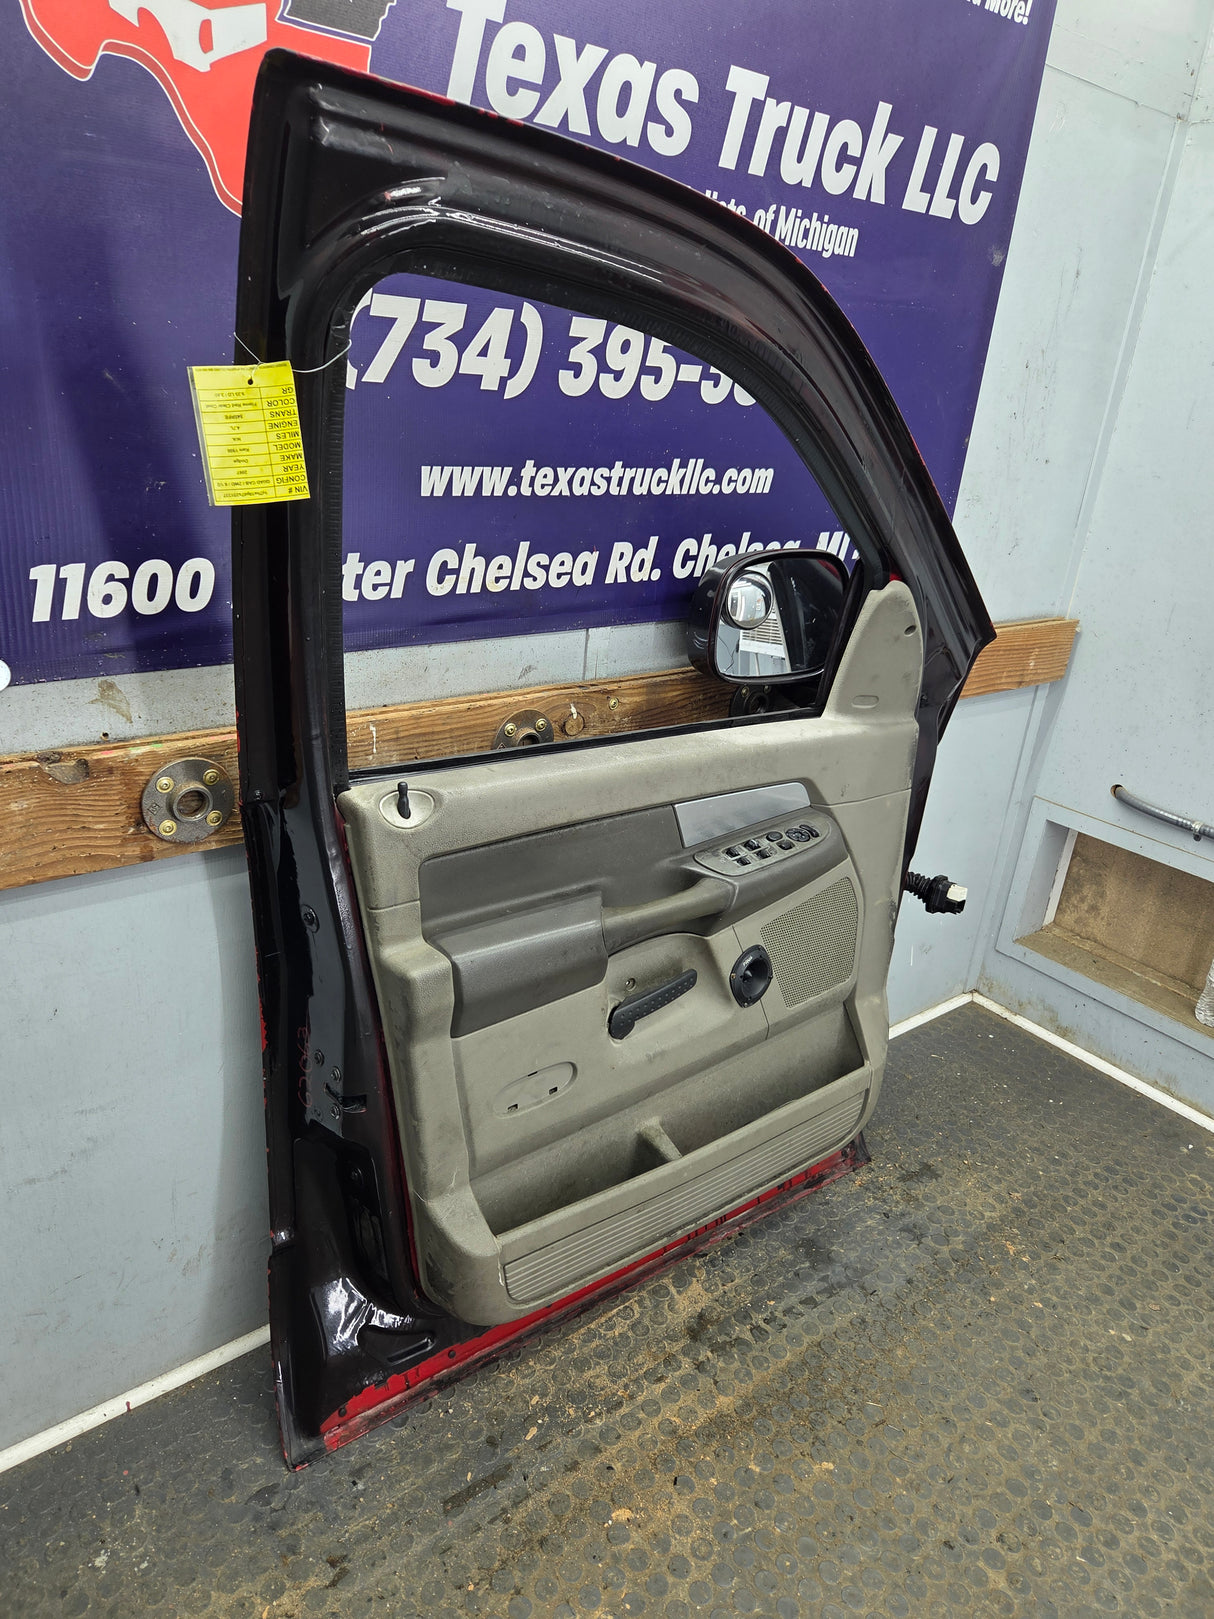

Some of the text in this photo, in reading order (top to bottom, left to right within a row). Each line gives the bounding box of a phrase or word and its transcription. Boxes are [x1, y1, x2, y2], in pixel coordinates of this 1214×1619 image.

[446, 0, 1001, 225] Texas Truck LLC
[753, 203, 778, 239] of
[774, 205, 860, 259] Michigan
[346, 287, 757, 407] (734) 395-3
[282, 386, 294, 394] GR
[267, 397, 296, 408] COLOR
[270, 409, 296, 419] TRANS
[268, 420, 298, 430] ENGINE
[276, 431, 300, 440] MILES
[273, 441, 301, 451] MODEL
[280, 452, 303, 462] MAKE
[283, 464, 304, 473] YEAR
[276, 474, 306, 484] CONFIG
[420, 458, 775, 497] www.texastruckllc.com
[294, 485, 308, 494] VIN
[28, 557, 217, 624] 11600
[425, 540, 599, 597] Chelsea
[604, 535, 662, 585] Rd.
